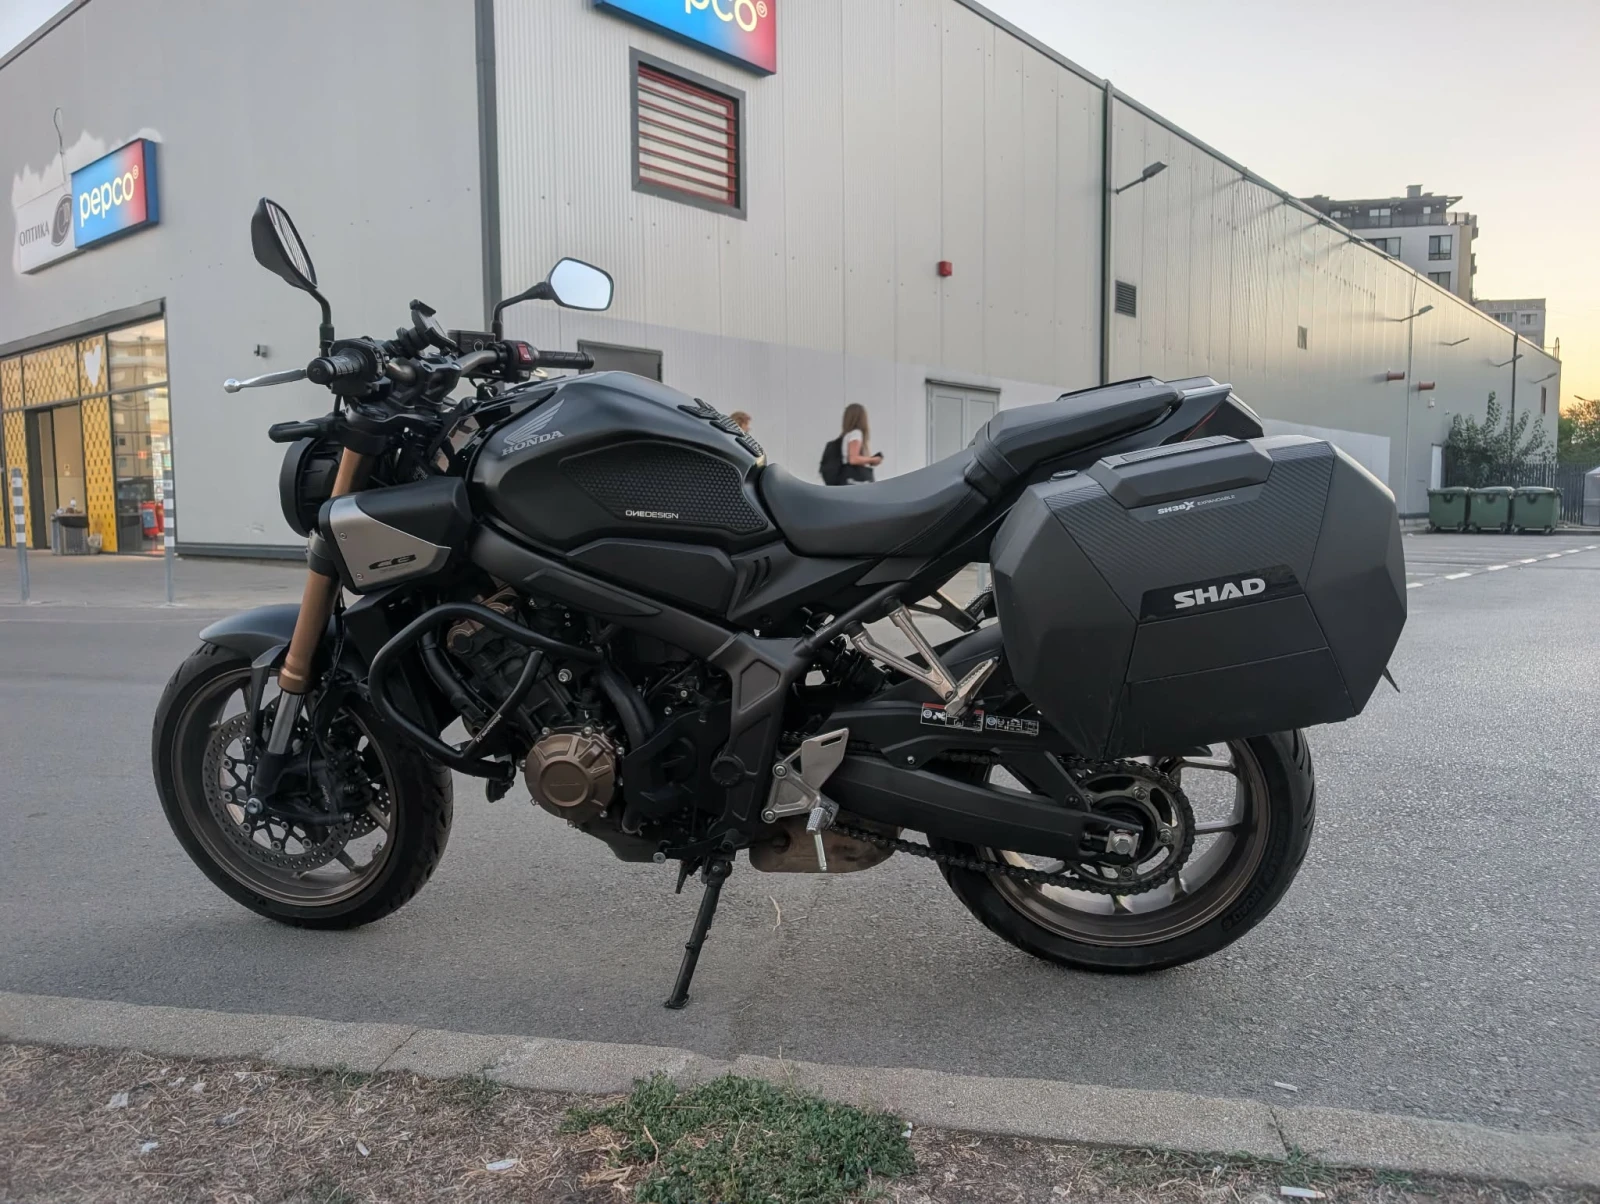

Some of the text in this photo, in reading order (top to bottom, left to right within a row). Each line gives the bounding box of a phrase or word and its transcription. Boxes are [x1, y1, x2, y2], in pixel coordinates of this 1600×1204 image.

[20, 220, 50, 247] ОПТИКА
[501, 430, 565, 457] HONDA
[625, 509, 679, 519] ONEDESIGN
[1173, 577, 1266, 609] SHAD
